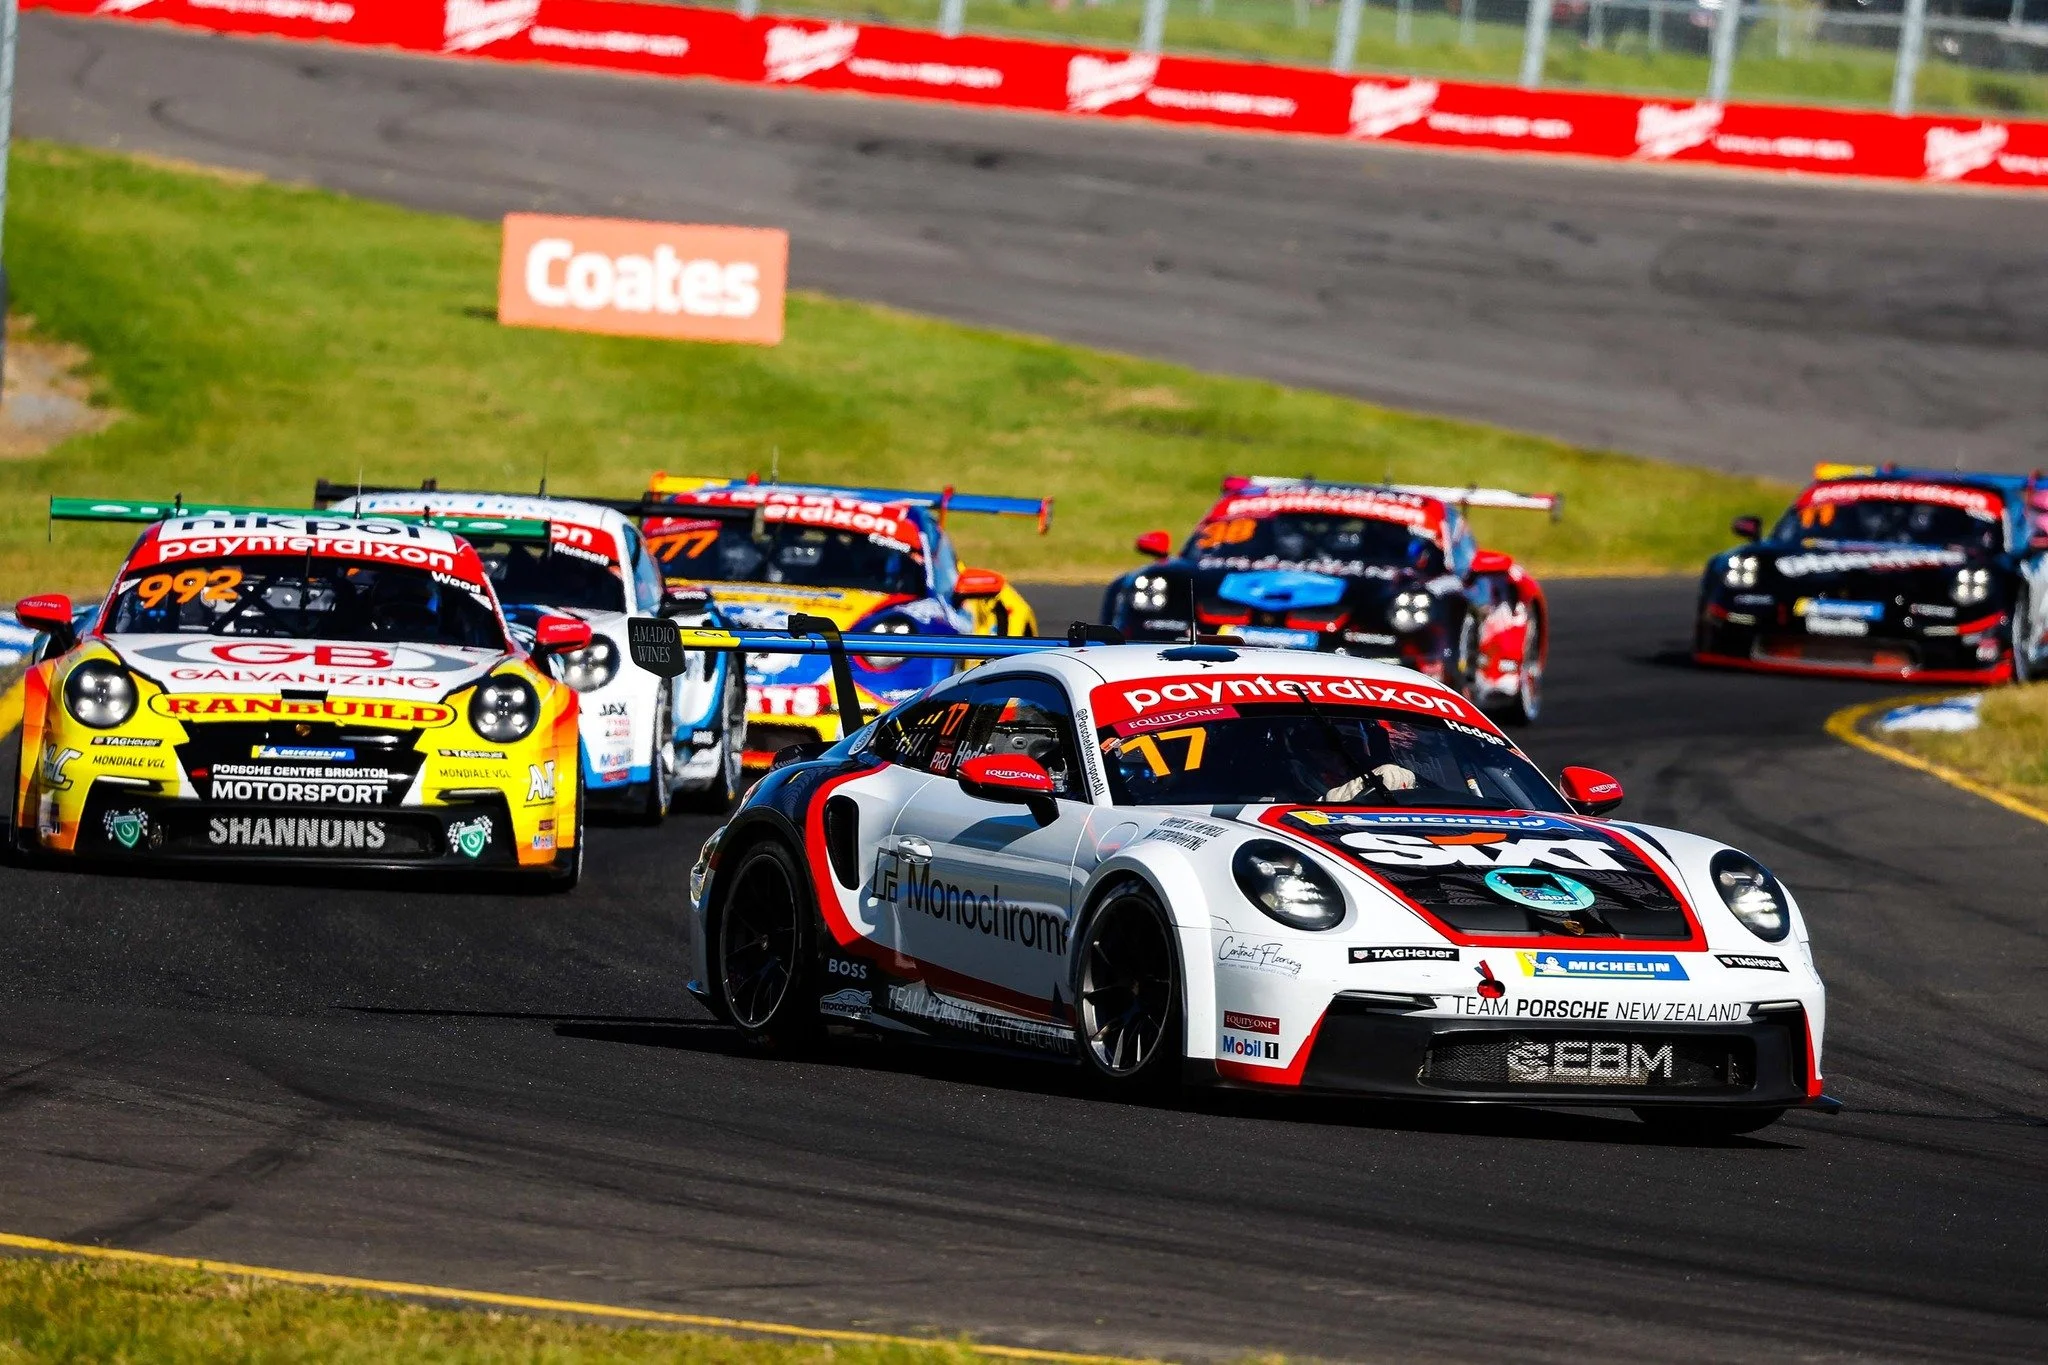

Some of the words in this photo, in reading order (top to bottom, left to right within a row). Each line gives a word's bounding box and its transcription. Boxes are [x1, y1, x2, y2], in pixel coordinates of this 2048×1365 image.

[525, 238, 759, 317] Coates
[763, 504, 898, 535] erdixon
[158, 536, 453, 571] paynterdixon
[138, 567, 243, 609] 992
[431, 571, 481, 594] Wood
[632, 625, 676, 644] AMADIO
[211, 643, 394, 669] GB
[637, 645, 671, 664] WINES
[1123, 675, 1466, 717] paynterdixon
[168, 698, 449, 722] RANBUILD
[600, 702, 628, 716] JAX
[941, 703, 970, 735] 17
[1443, 719, 1506, 746] Hedge
[92, 755, 145, 768] MONDIALE
[147, 758, 166, 768] VGL
[281, 749, 347, 758] MICHELIN
[930, 751, 952, 771] PRO
[1076, 708, 1105, 796] @PorscheMotorsportAU
[1119, 726, 1207, 777] 17
[213, 763, 271, 776] PORSCHE
[273, 765, 323, 777] CENTRE
[325, 767, 389, 778] BRIGHTON
[440, 769, 489, 779] MONDIALE
[211, 780, 389, 805] MOTORSPORT
[208, 817, 386, 849] SHANNONS
[1378, 816, 1547, 828] MICHELIN
[1219, 936, 1262, 961] Contract
[1260, 943, 1302, 975] Flooring
[1568, 960, 1671, 973] MICHELIN
[828, 958, 867, 980] BOSS
[820, 1000, 873, 1016] motorsport
[1453, 996, 1509, 1016] TEAM
[1515, 999, 1609, 1020] PORSCHE
[1615, 1001, 1663, 1020] NEW
[1664, 1002, 1742, 1022] ZEALAND
[1223, 1035, 1261, 1058] Mobil
